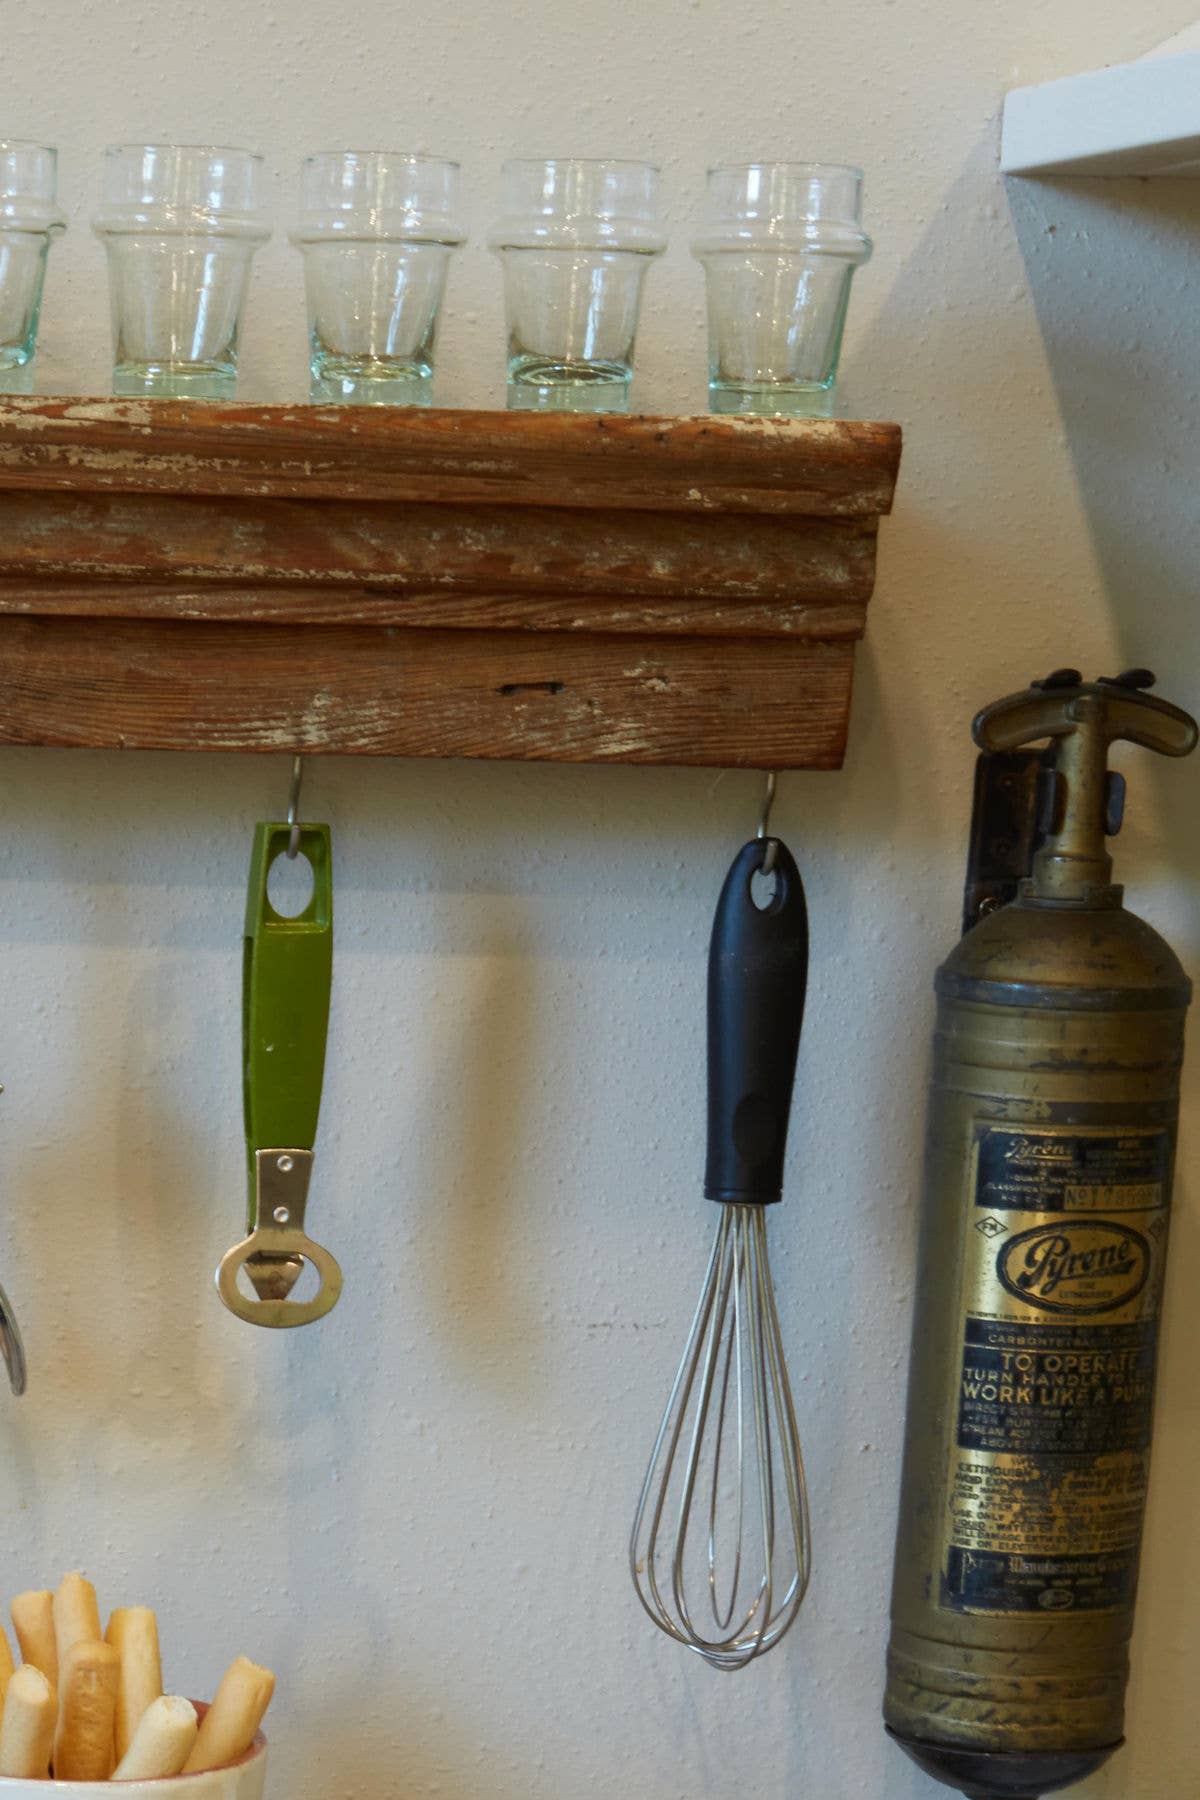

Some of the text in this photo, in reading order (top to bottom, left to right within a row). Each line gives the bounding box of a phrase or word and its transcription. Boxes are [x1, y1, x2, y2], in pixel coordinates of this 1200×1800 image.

[1016, 1234, 1137, 1296] Pyrene
[1002, 1353, 1033, 1372] TO
[964, 1368, 1014, 1384] TURN
[962, 1381, 1031, 1405] WORK
